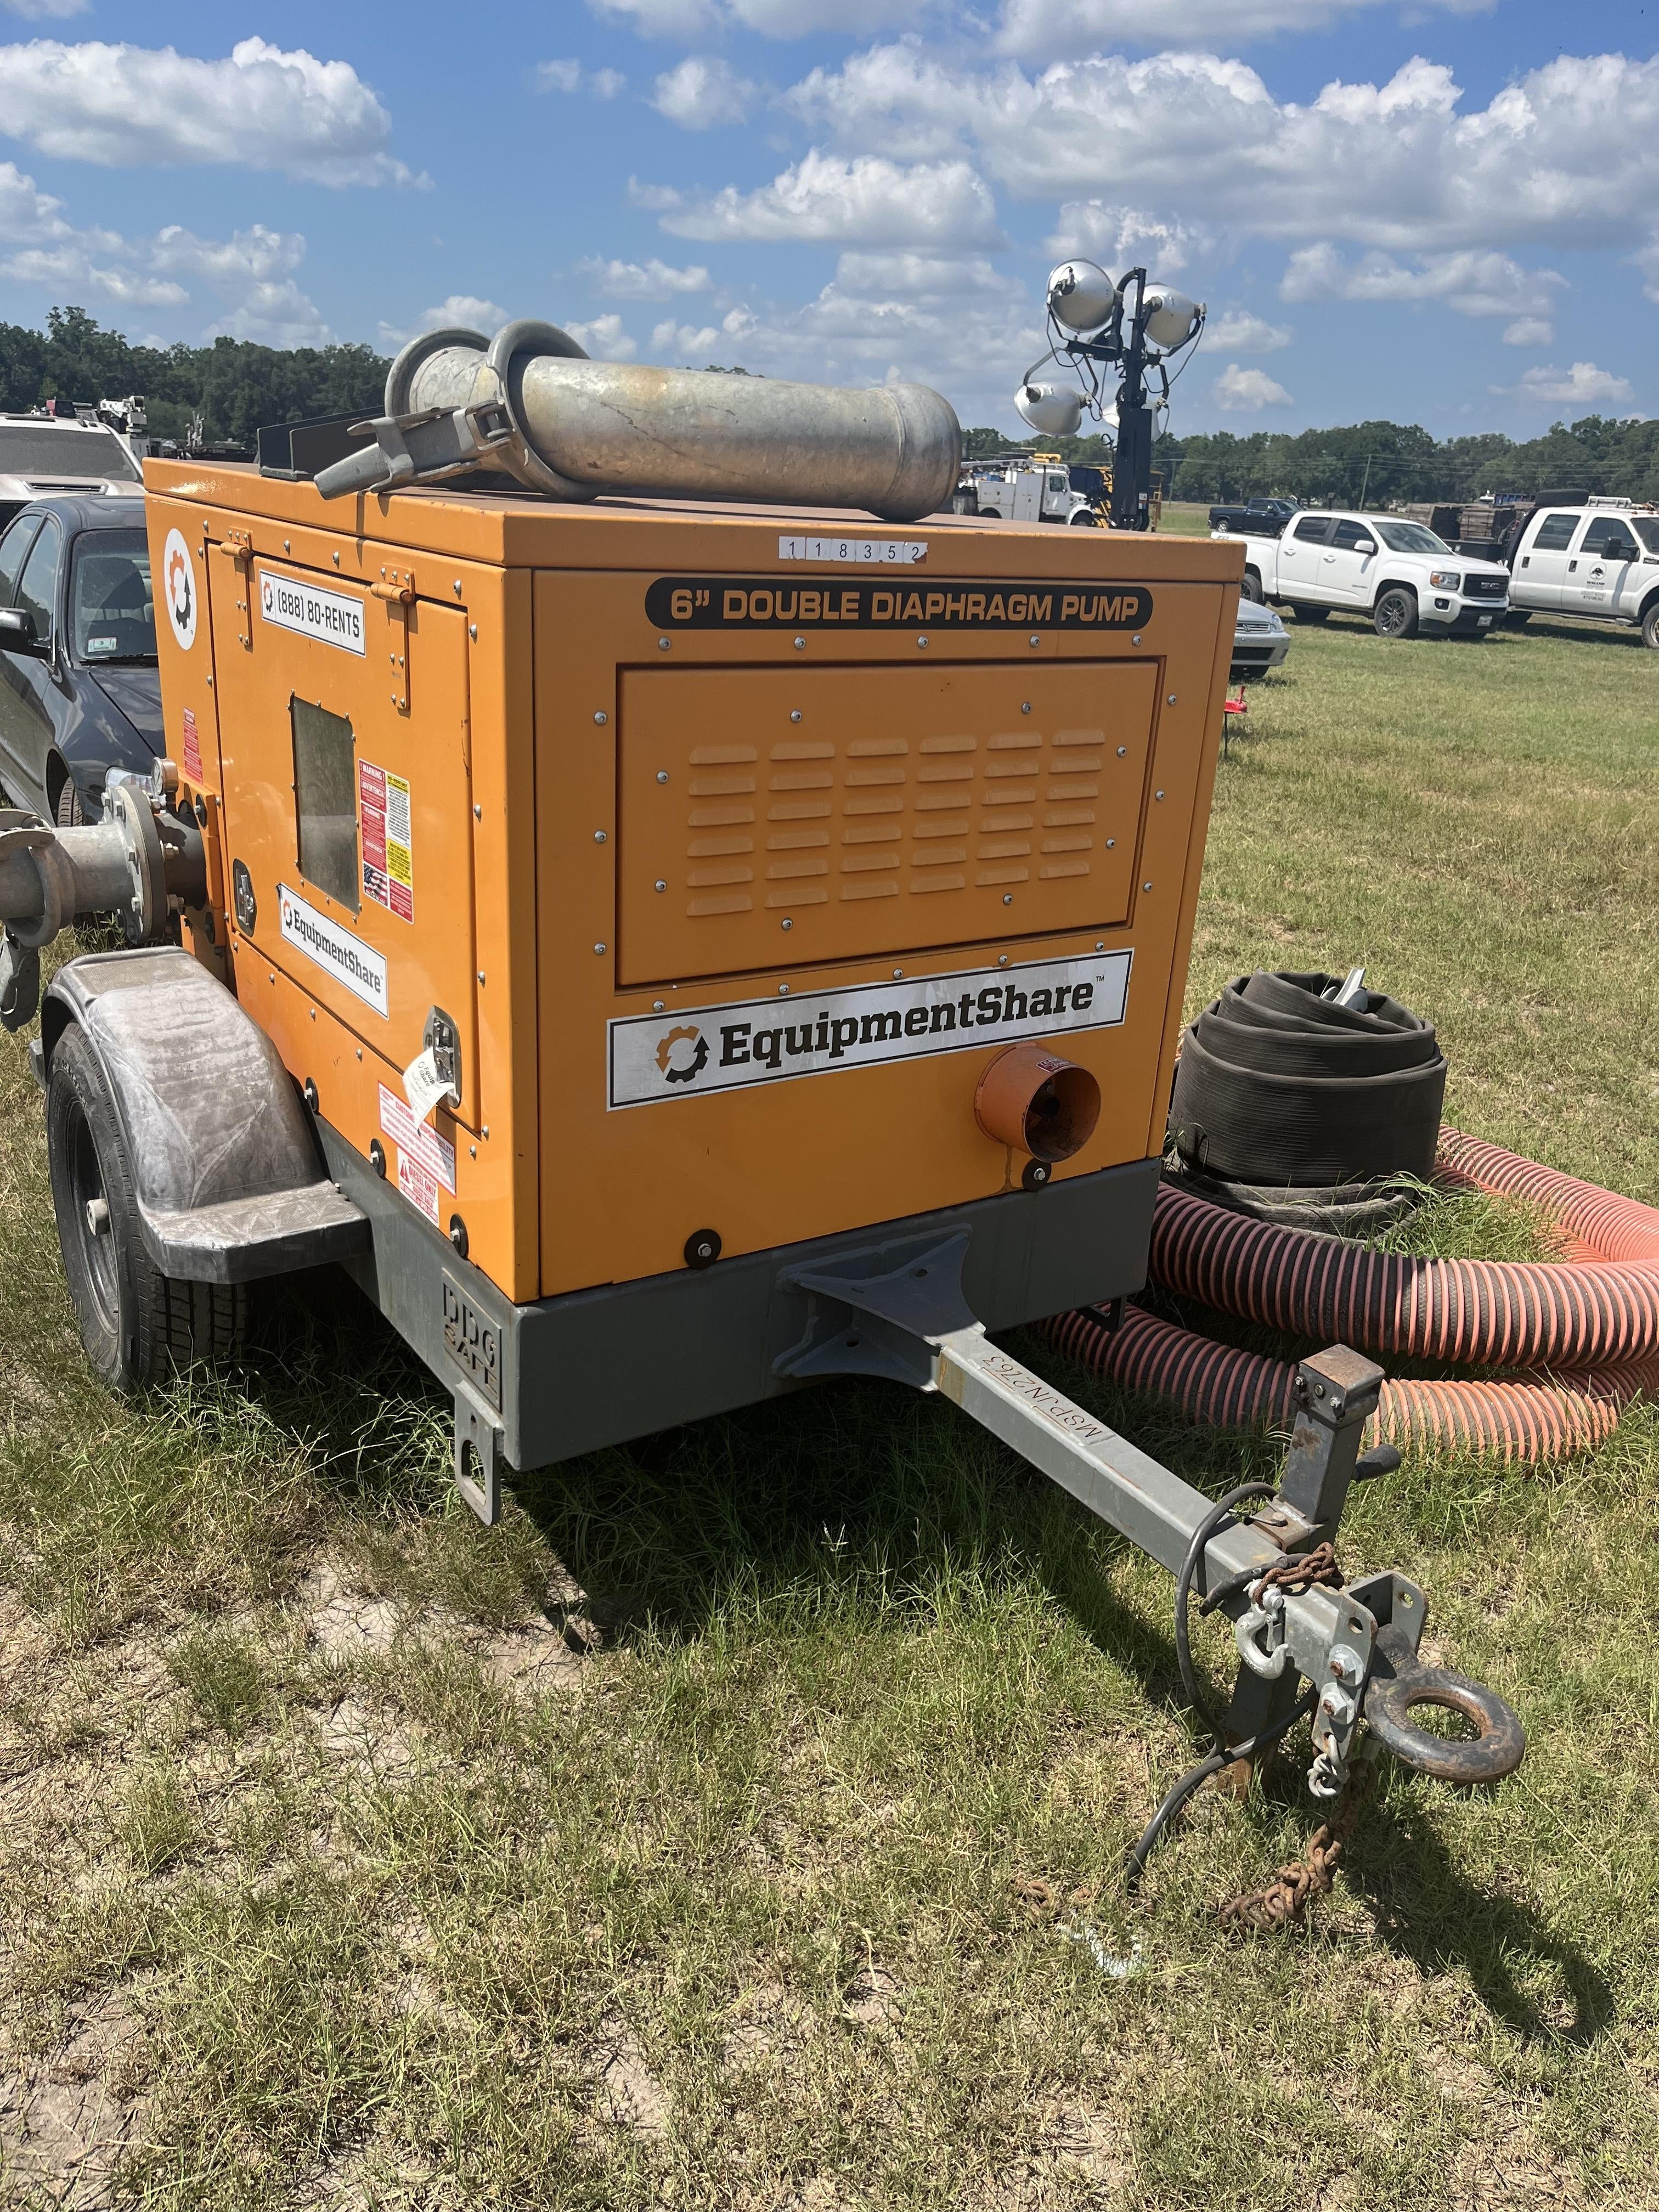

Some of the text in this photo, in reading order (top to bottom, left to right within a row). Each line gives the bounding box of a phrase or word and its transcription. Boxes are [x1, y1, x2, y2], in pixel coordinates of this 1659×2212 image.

[278, 588, 359, 638] (888) 80-RENTS
[723, 590, 860, 620] DOUBLE
[871, 592, 1052, 621] DIAPHRAGM
[1061, 595, 1139, 622] PUMP
[362, 763, 383, 781] WARNING
[294, 909, 381, 994] EquipmentShare
[719, 982, 1093, 1069] EquipmentShare
[419, 1070, 430, 1087] Share
[424, 1066, 435, 1084] Equip
[396, 1101, 415, 1123] CUSTOME
[420, 1123, 454, 1158] ESPONSIBILITY
[409, 1165, 424, 1187] DIESEL
